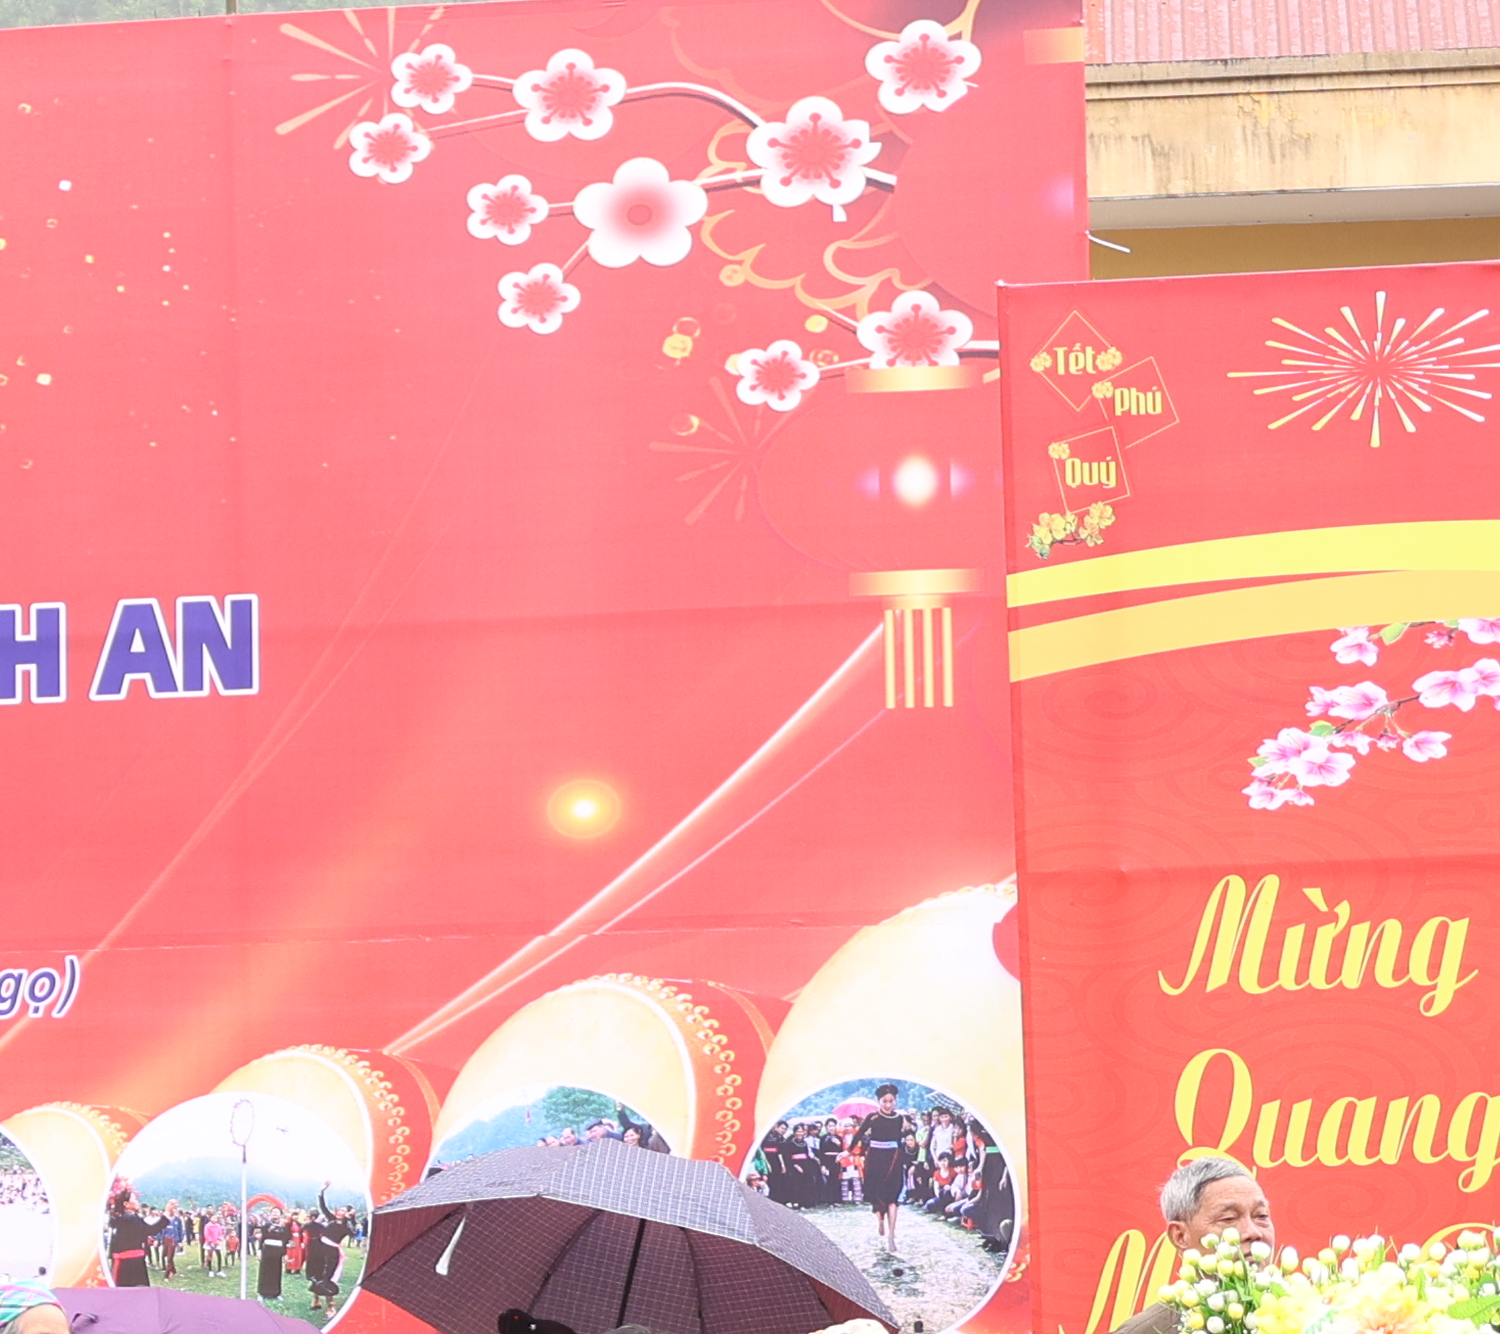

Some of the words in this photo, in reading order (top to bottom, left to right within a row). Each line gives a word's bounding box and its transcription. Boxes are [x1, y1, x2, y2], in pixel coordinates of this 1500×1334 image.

[1053, 342, 1096, 375] Tết
[1114, 386, 1162, 416] Phú
[1065, 455, 1117, 489] Quý
[92, 596, 257, 699] AN
[1158, 874, 1479, 1017] Mừng
[1175, 1049, 1500, 1192] Quang
